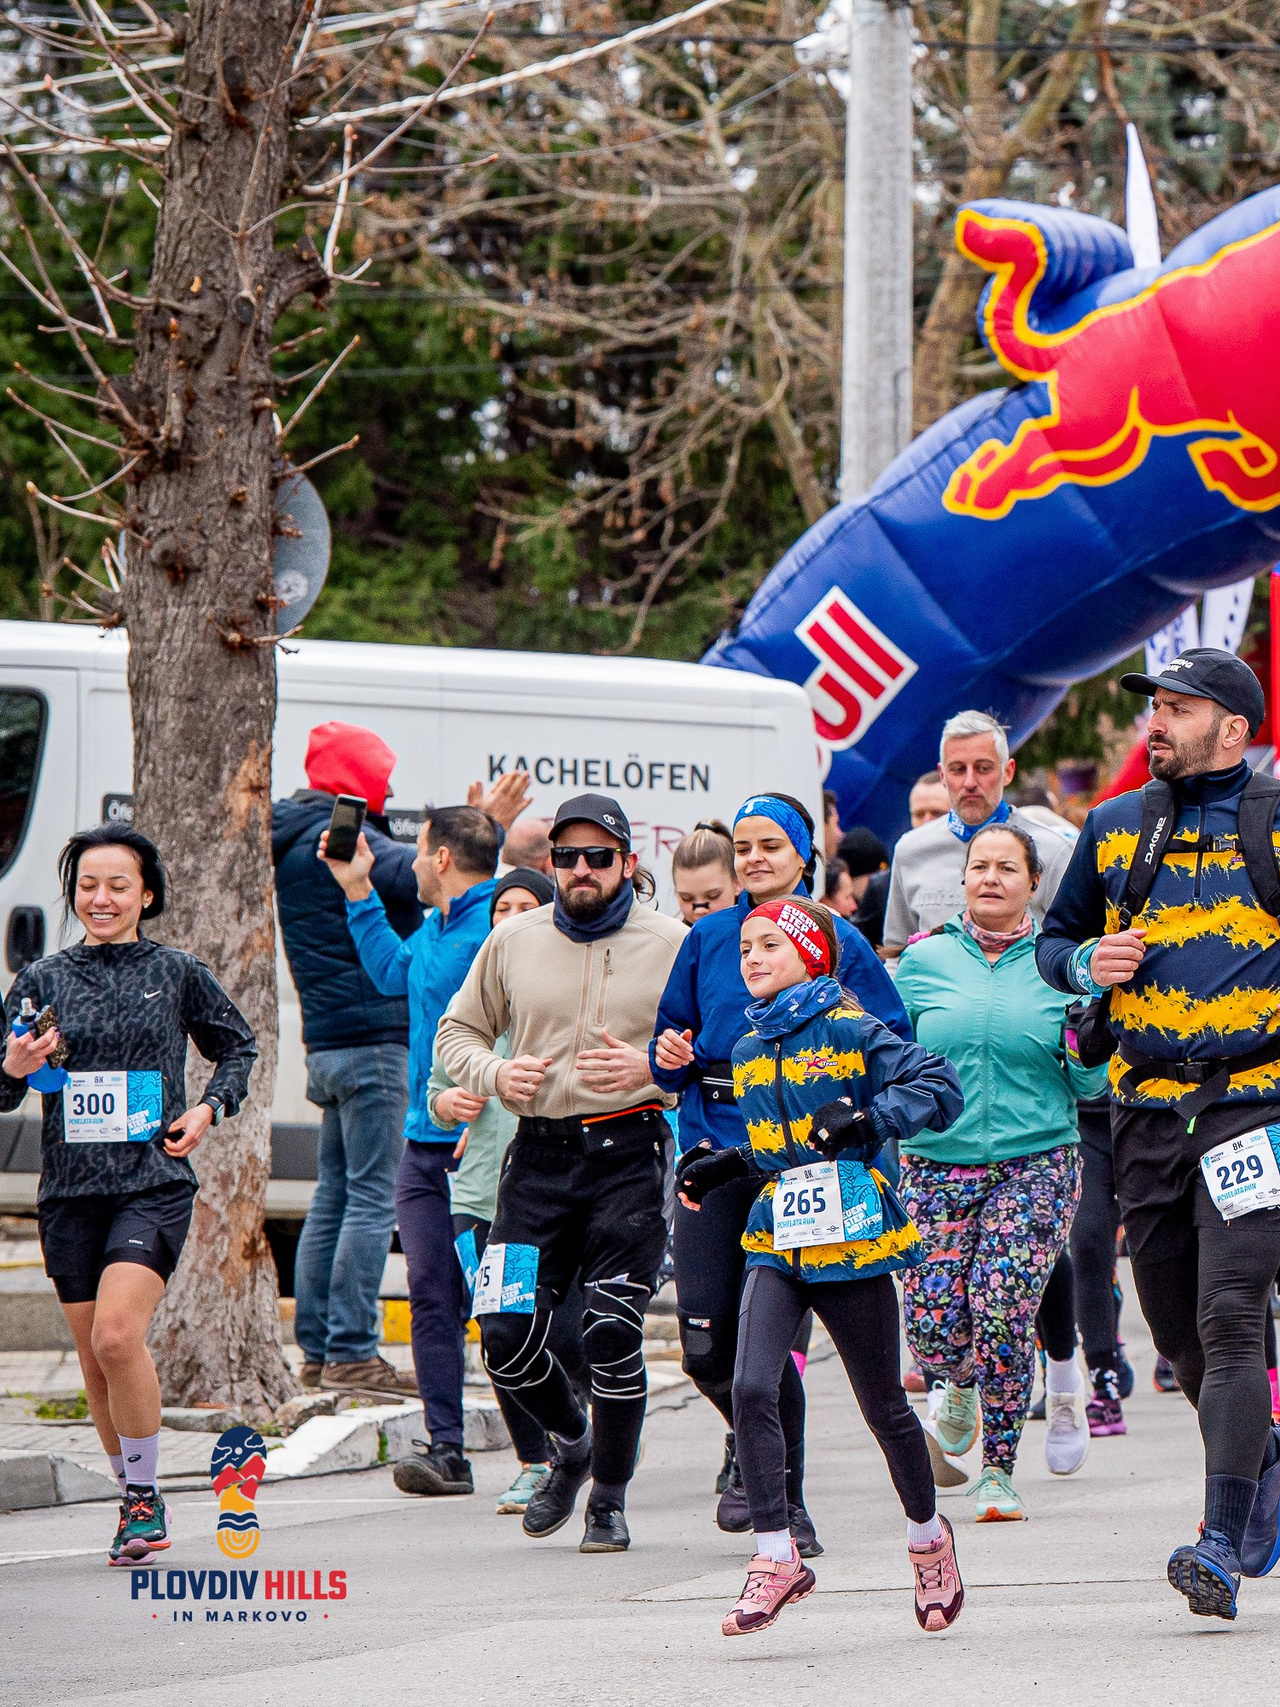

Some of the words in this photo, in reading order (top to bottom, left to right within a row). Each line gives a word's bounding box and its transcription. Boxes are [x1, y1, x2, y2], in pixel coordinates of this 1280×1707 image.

[811, 598, 906, 766] ull
[489, 753, 710, 792] KACHELÖFEN
[1144, 816, 1167, 865] DAKINE
[780, 910, 809, 934] STEP
[783, 904, 819, 933] EVERY
[776, 917, 823, 961] MATTERS
[72, 1093, 115, 1115] 300
[1232, 1140, 1244, 1151] 8K
[803, 1168, 814, 1180] 8K
[1216, 1154, 1264, 1191] 229
[783, 1186, 826, 1218] 265
